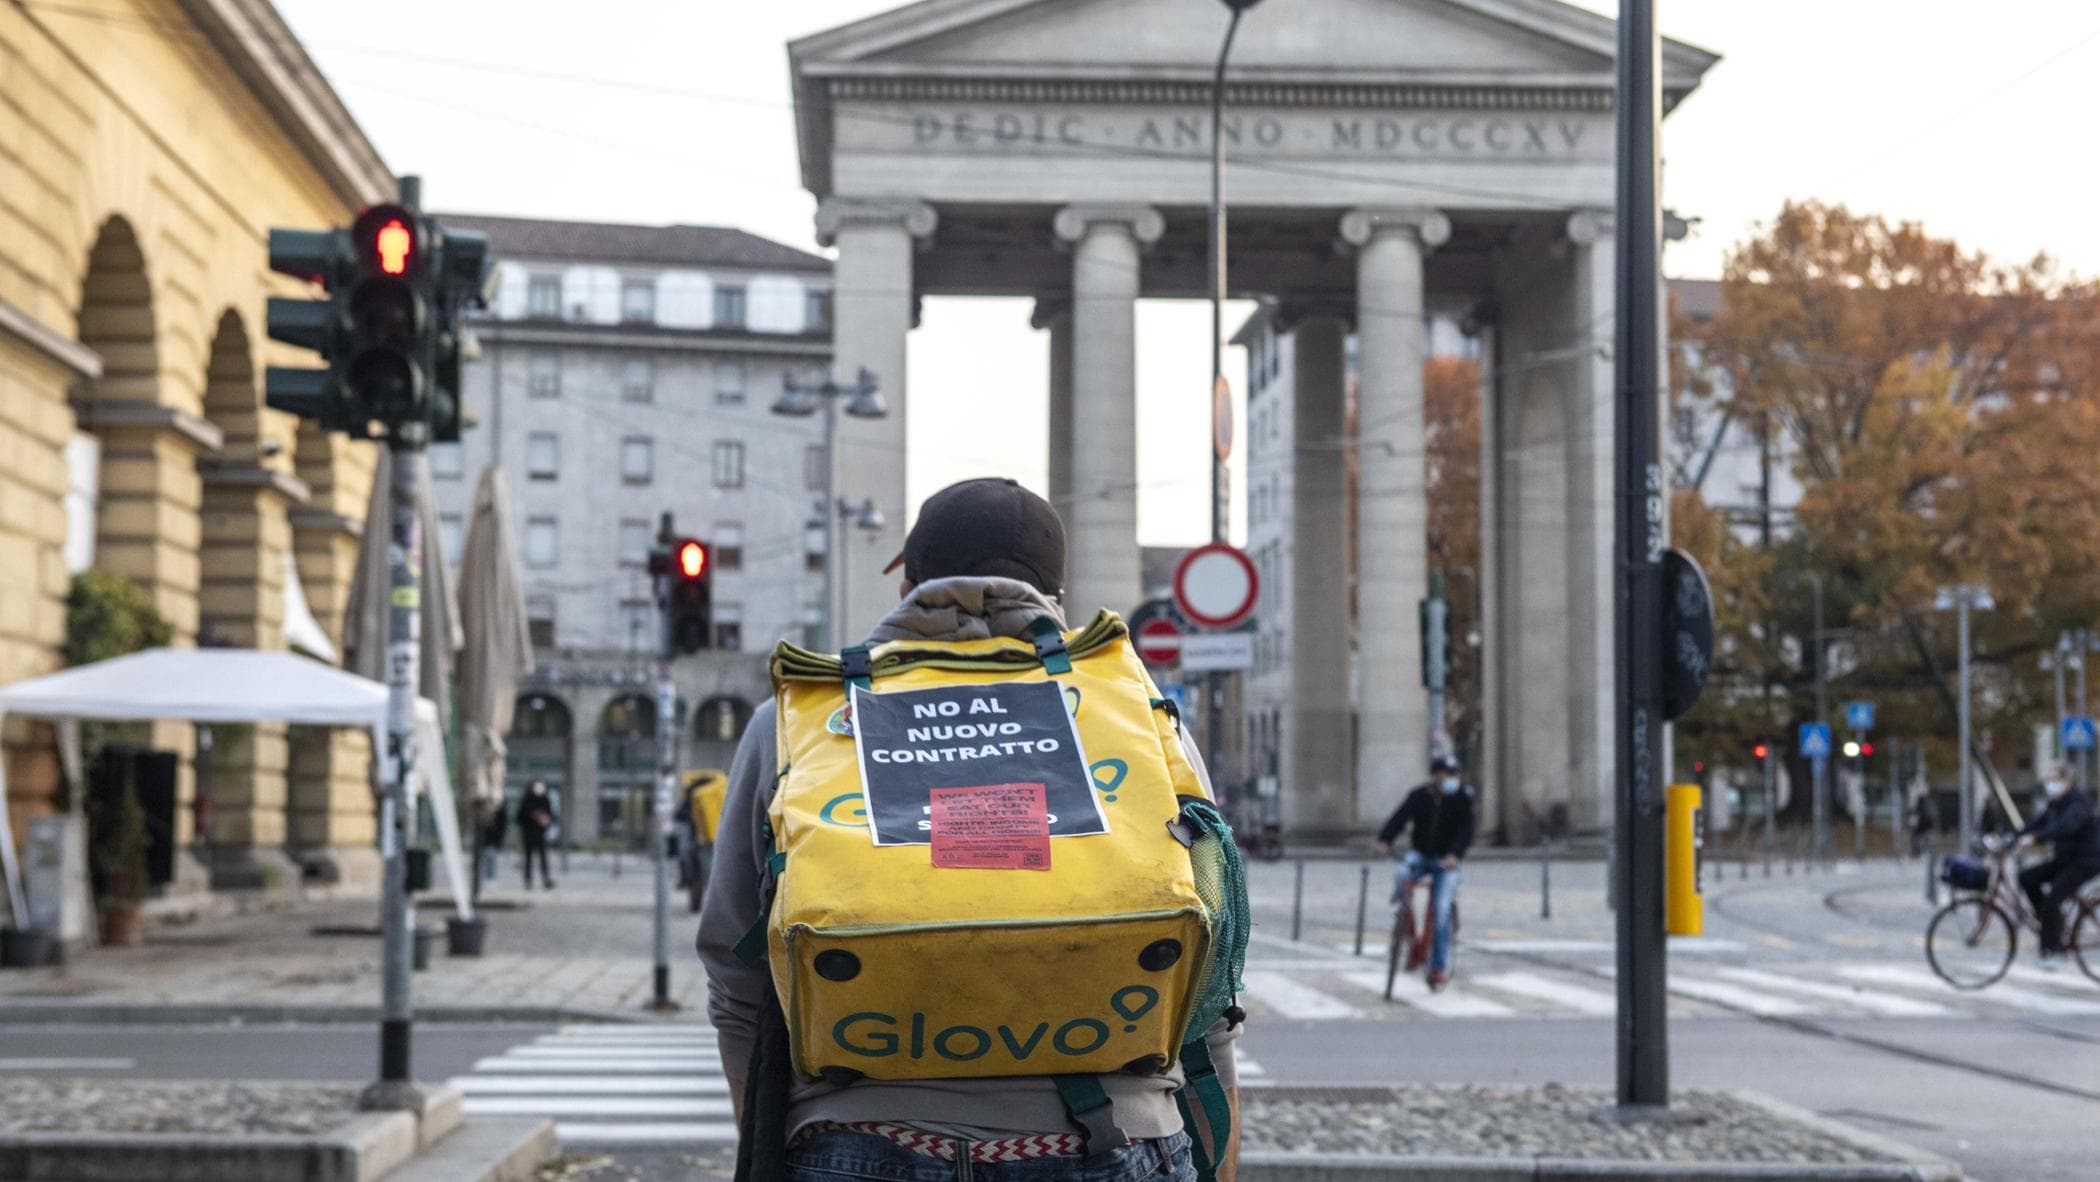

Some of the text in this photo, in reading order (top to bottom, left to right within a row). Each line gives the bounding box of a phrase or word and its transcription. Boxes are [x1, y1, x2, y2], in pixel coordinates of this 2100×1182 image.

[912, 112, 1585, 150] DEDIC ANNO MDCCCXV
[913, 697, 1008, 719] NO AL
[907, 721, 1022, 742] NUOVO
[871, 738, 1059, 763] CONTRATTO
[832, 1011, 1110, 1062] Glovo
